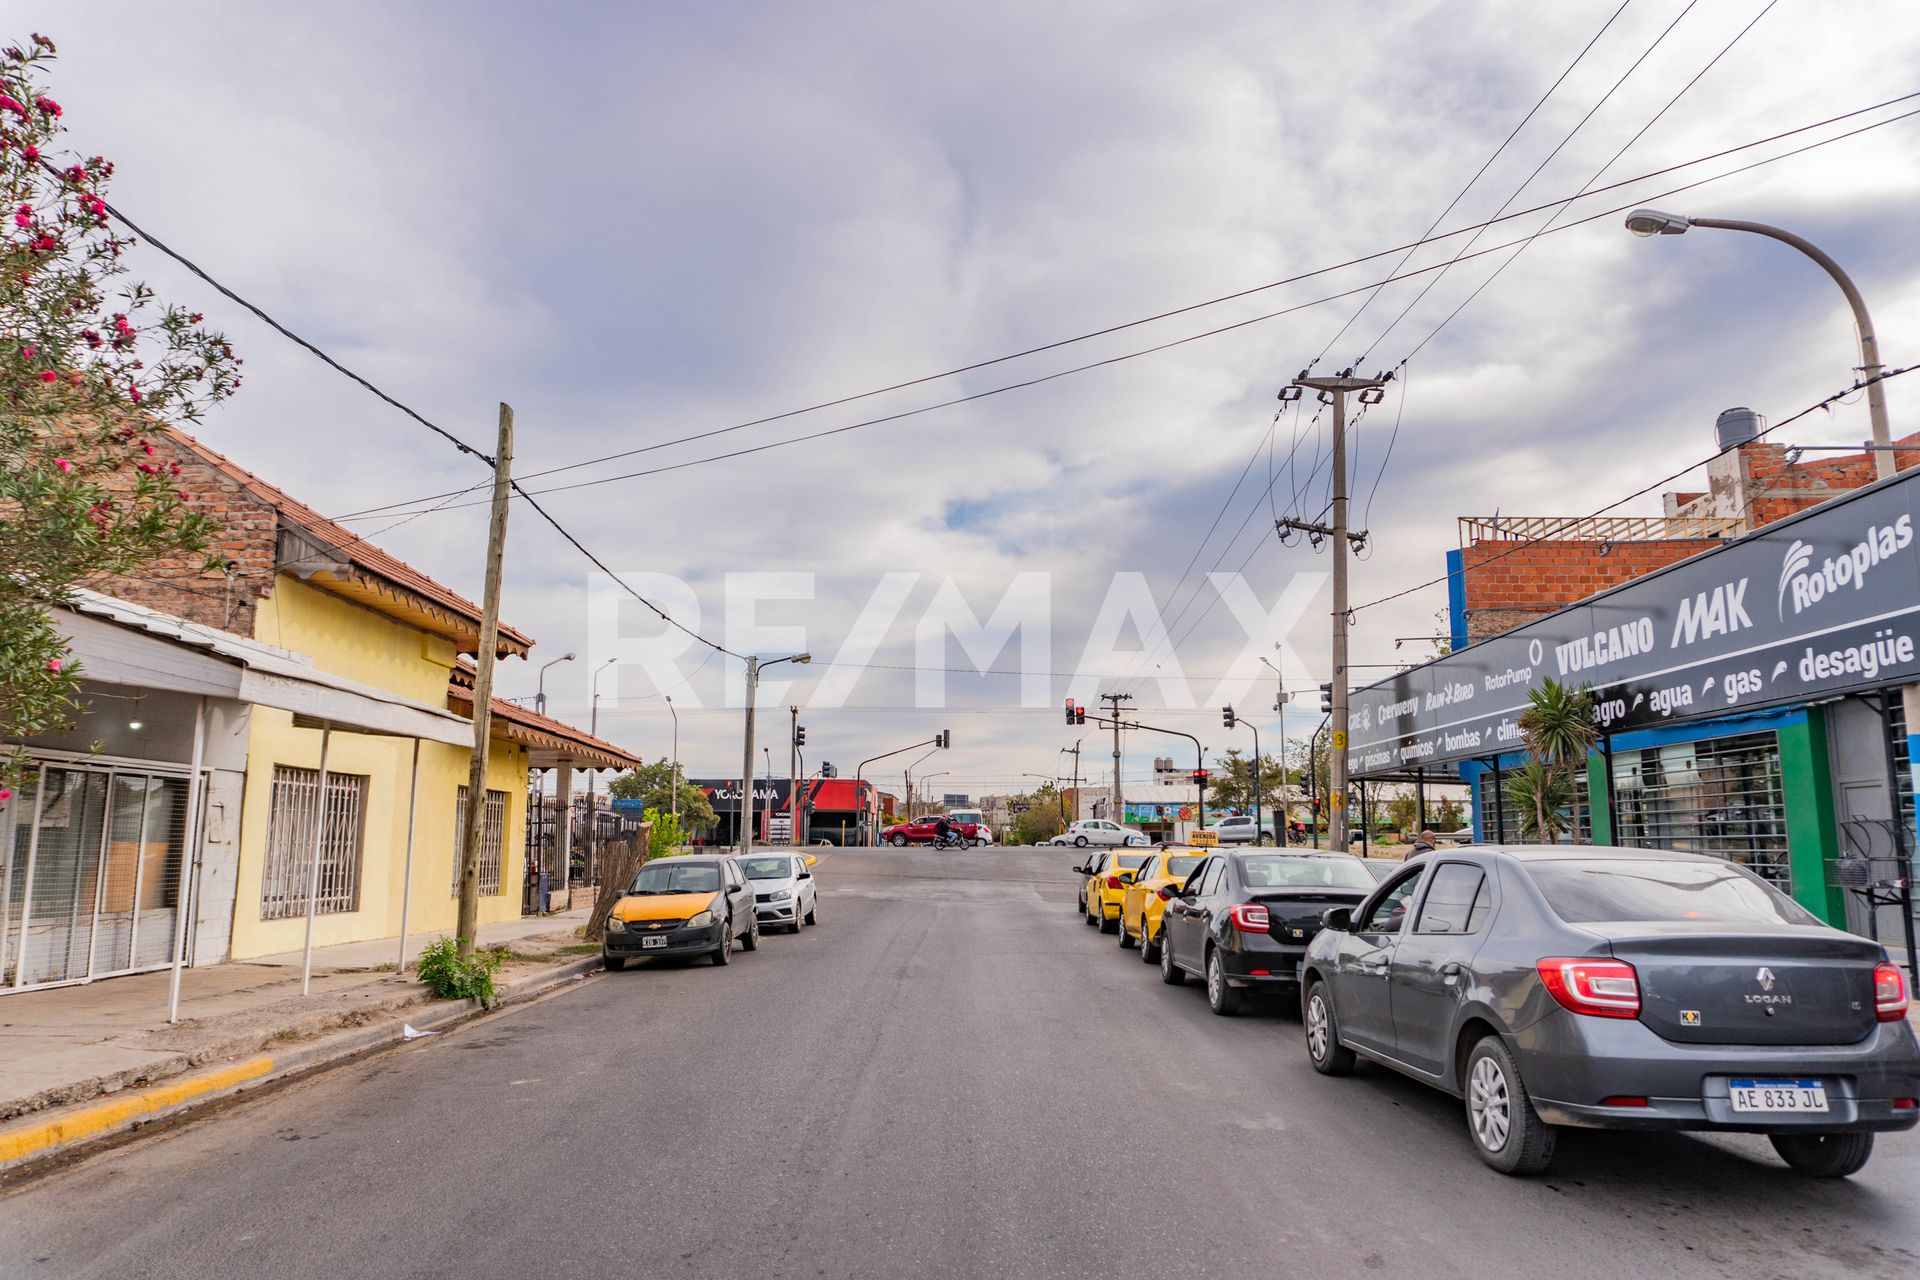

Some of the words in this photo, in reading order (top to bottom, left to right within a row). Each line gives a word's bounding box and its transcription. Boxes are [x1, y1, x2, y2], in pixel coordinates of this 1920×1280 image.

[1791, 514, 1913, 614] Rotoplas
[1671, 577, 1754, 649] MAK
[1555, 616, 1655, 676] VULCANO
[1484, 666, 1532, 691] RotorPump
[1348, 757, 1358, 773] ego
[1364, 748, 1391, 772] piscinas
[1400, 739, 1434, 765] químicos
[1446, 728, 1481, 752] bombas
[1650, 684, 1694, 717] agua
[1724, 668, 1763, 704] gas
[1799, 628, 1915, 683] desagüe
[1453, 683, 1475, 704] BIRD
[1348, 712, 1361, 731] GRE
[1378, 696, 1419, 725] Czerweny
[714, 789, 779, 800] YOKOAMA
[1744, 995, 1792, 1004] LOGAN
[1738, 1090, 1759, 1108] AE
[1764, 1090, 1796, 1108] 833
[1802, 1090, 1823, 1108] JL
